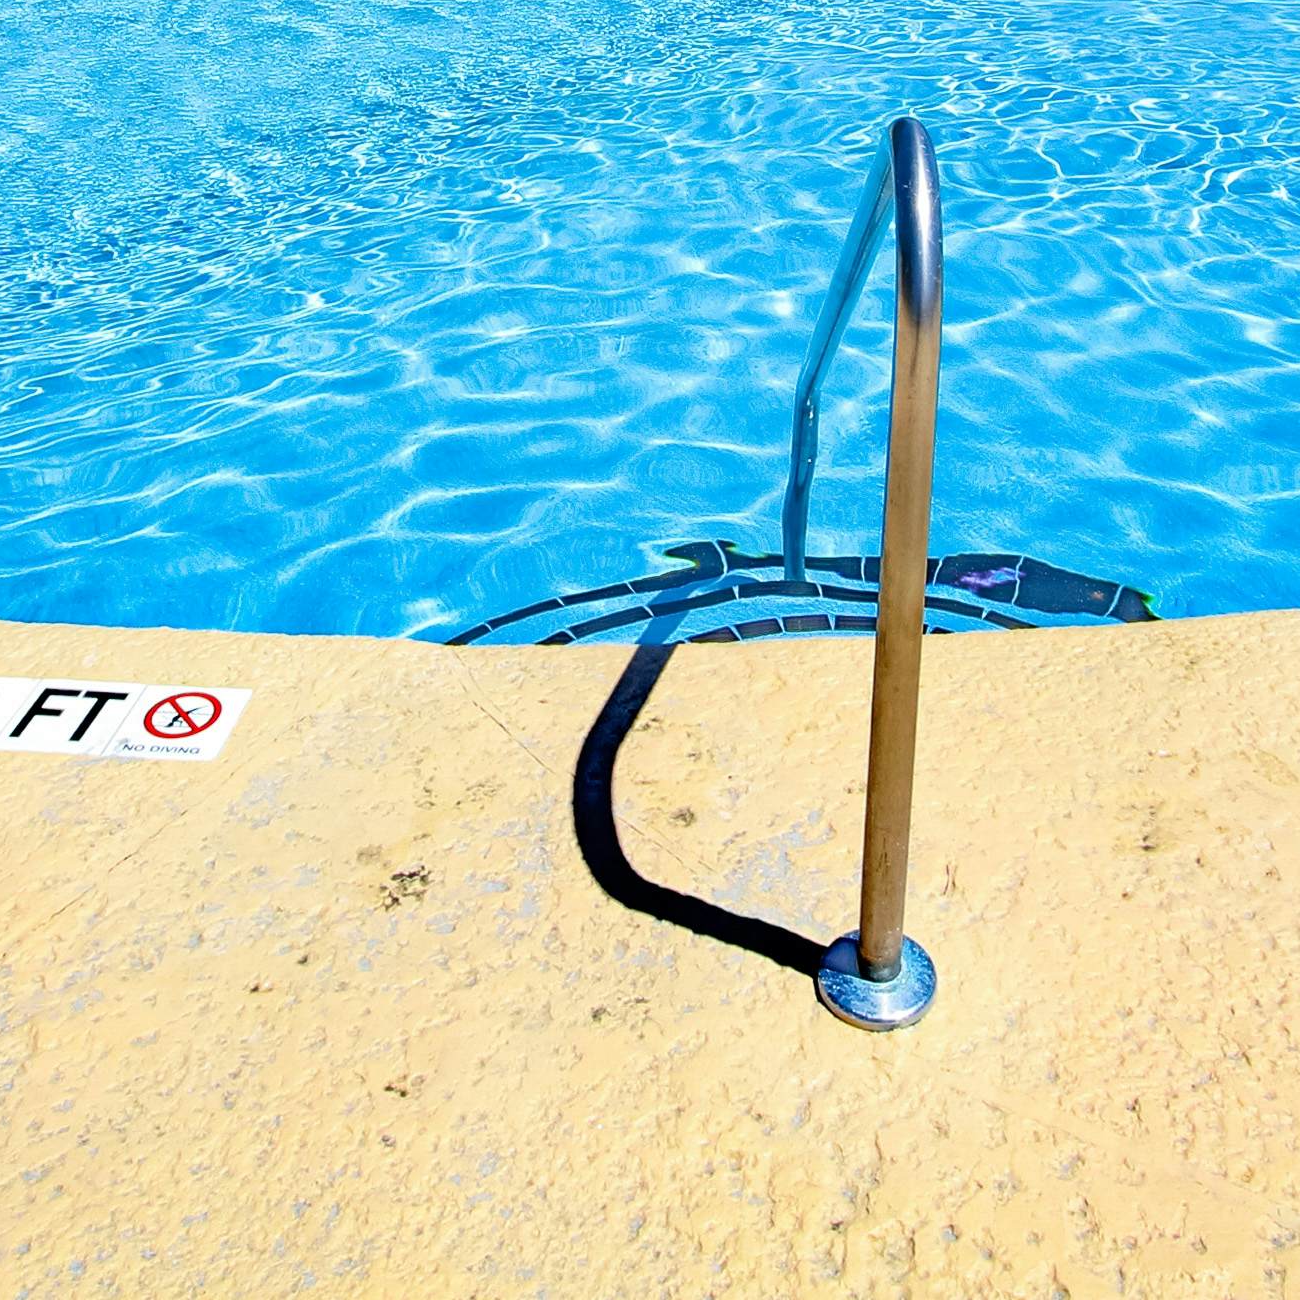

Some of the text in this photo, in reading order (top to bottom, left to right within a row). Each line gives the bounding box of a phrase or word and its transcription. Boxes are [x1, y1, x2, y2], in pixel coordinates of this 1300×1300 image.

[9, 688, 129, 741] FT
[122, 744, 201, 755] NO DIVING
